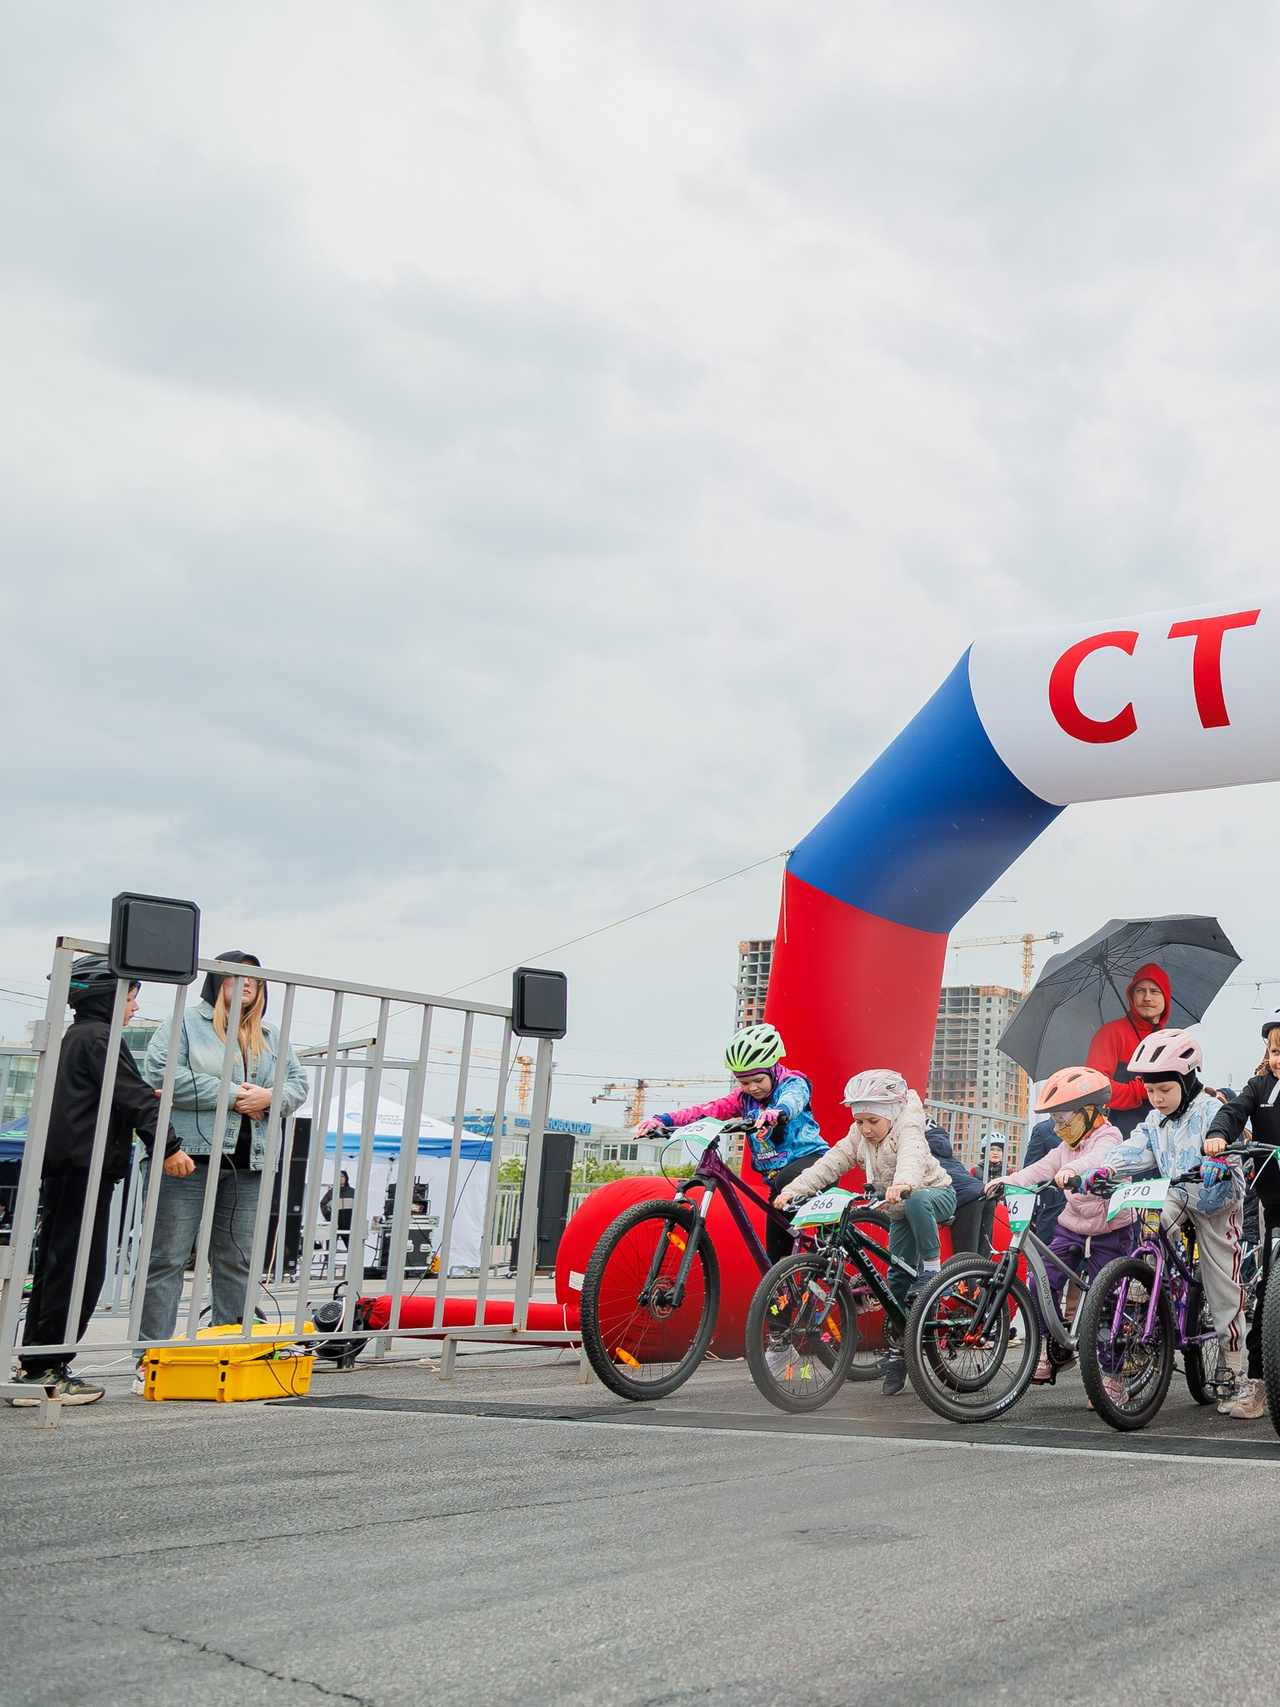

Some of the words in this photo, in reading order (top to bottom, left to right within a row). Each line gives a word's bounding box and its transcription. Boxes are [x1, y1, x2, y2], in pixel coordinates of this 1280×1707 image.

[1123, 1185, 1151, 1199] 870
[811, 1198, 834, 1211] 866
[858, 1249, 898, 1305] OUTLEAP
[996, 1390, 1018, 1410] KENDA
